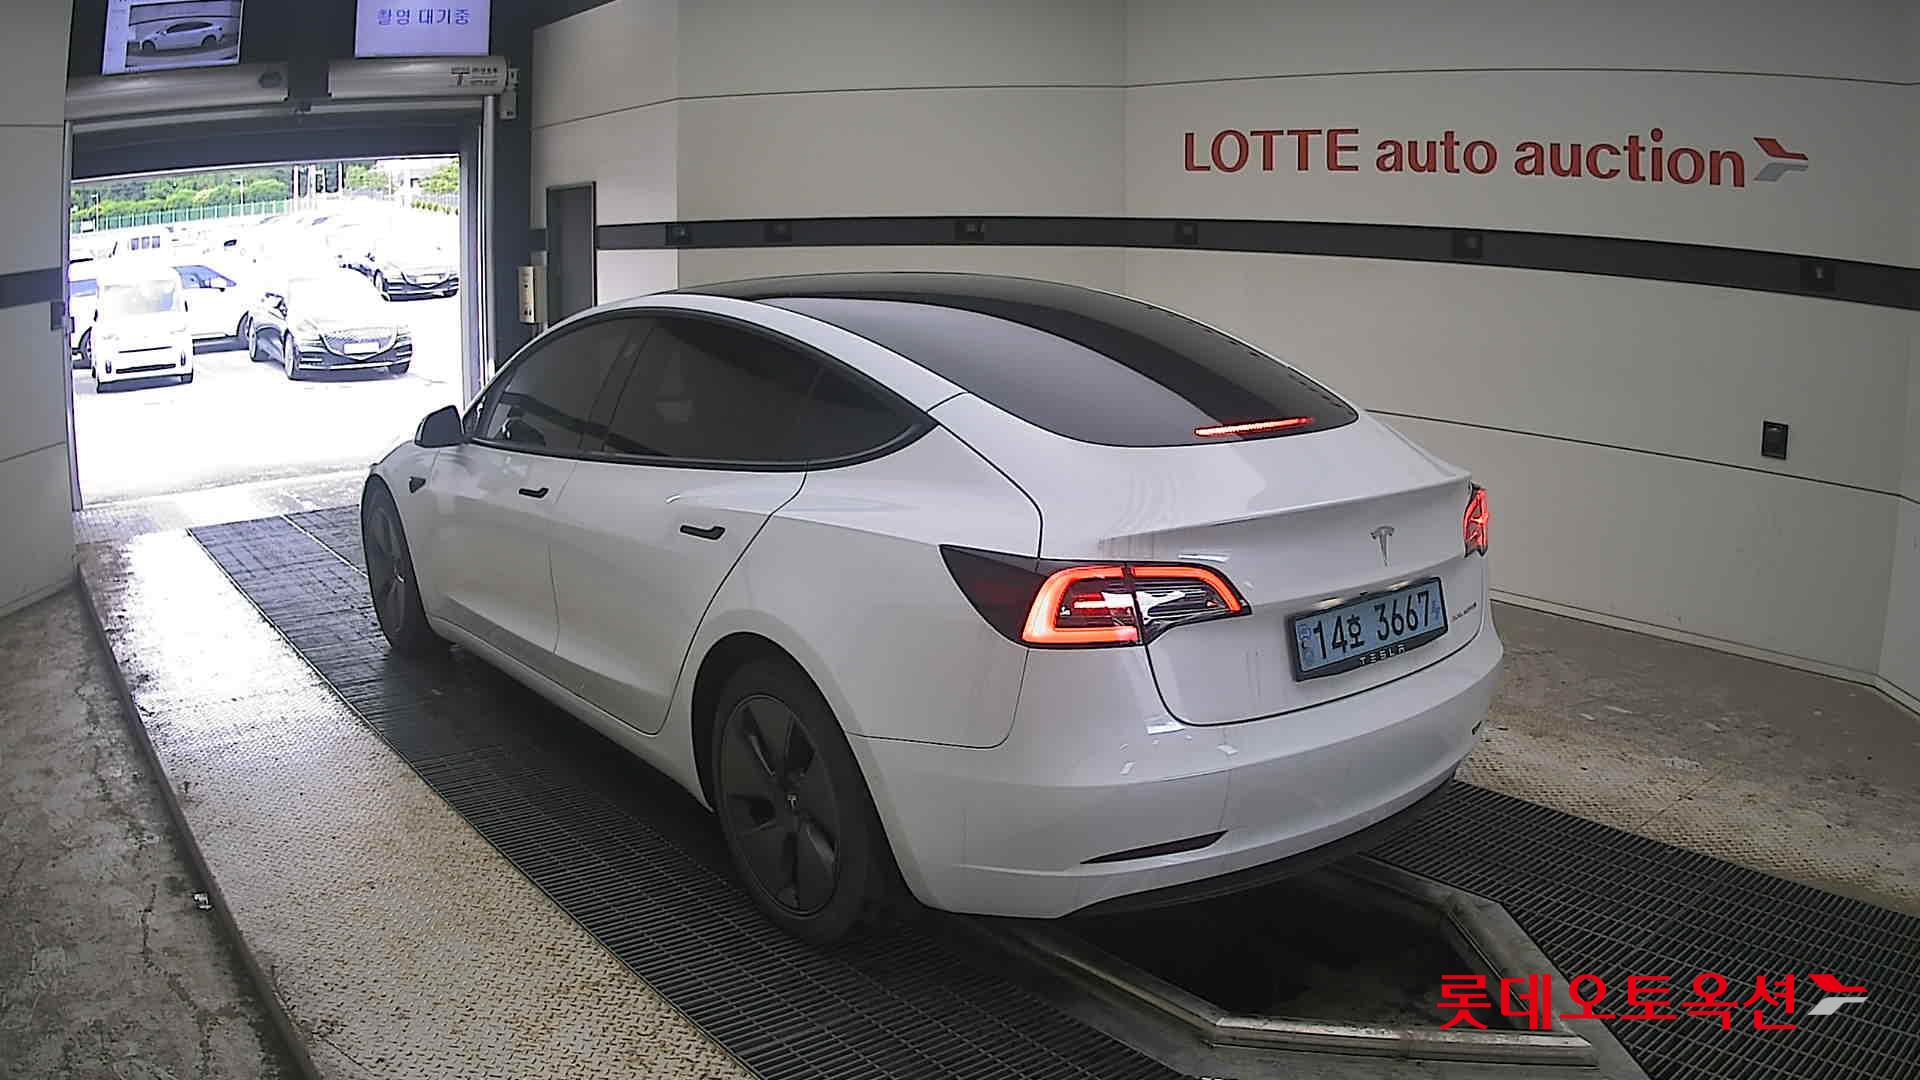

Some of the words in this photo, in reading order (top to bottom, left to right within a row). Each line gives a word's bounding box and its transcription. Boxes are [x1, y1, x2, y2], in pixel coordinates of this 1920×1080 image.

[418, 8, 469, 25] 대기중
[1184, 128, 1360, 173] LOTTE
[1376, 130, 1498, 175] auto
[1514, 128, 1746, 188] auction
[1313, 614, 1364, 660] 14호
[1374, 590, 1430, 640] 3667
[1360, 644, 1407, 665] TESLA
